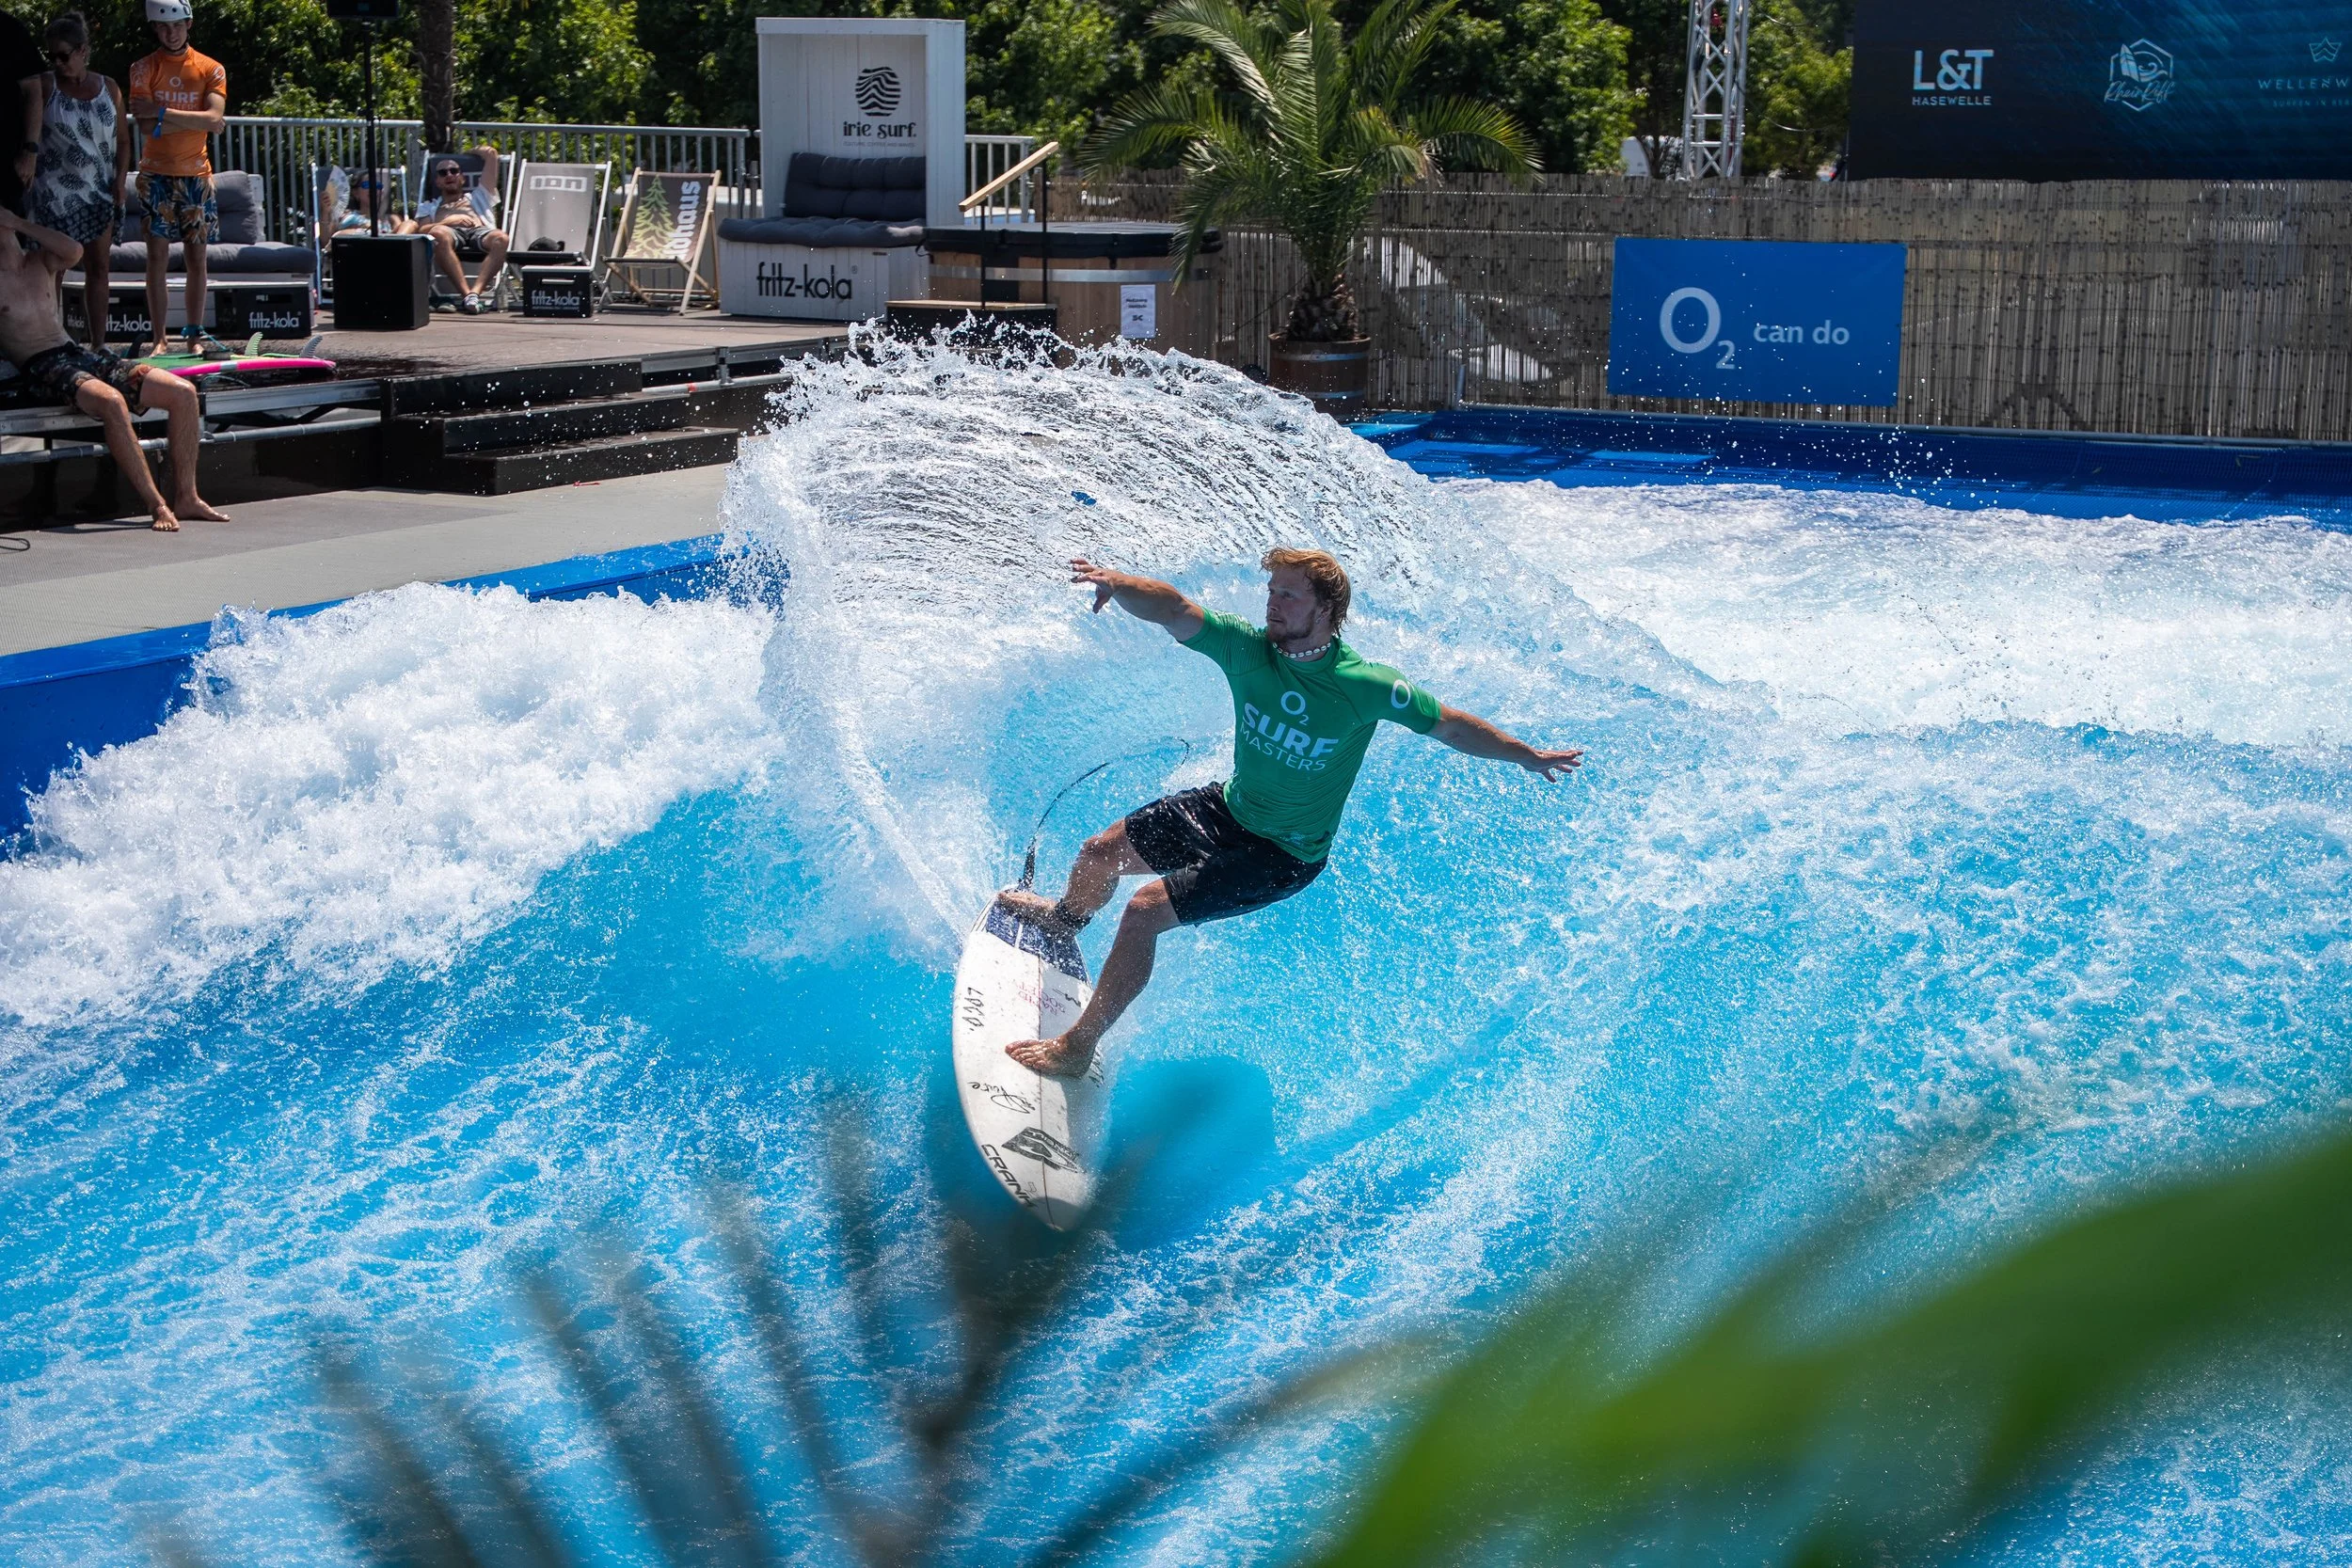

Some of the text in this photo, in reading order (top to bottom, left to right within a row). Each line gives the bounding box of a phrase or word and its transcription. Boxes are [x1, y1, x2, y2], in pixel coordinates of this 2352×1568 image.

[1913, 49, 1994, 91] L&T
[154, 89, 199, 104] SURF
[1912, 95, 1993, 106] HASEWELLE
[843, 120, 872, 137] irie
[756, 261, 852, 300] fritz-kola
[531, 290, 580, 307] fritz-kola
[248, 311, 299, 329] fritz-kola
[1753, 323, 1804, 344] can
[1812, 319, 1851, 345] do
[1242, 702, 1340, 758] SURF
[1240, 721, 1327, 771] MASTERS
